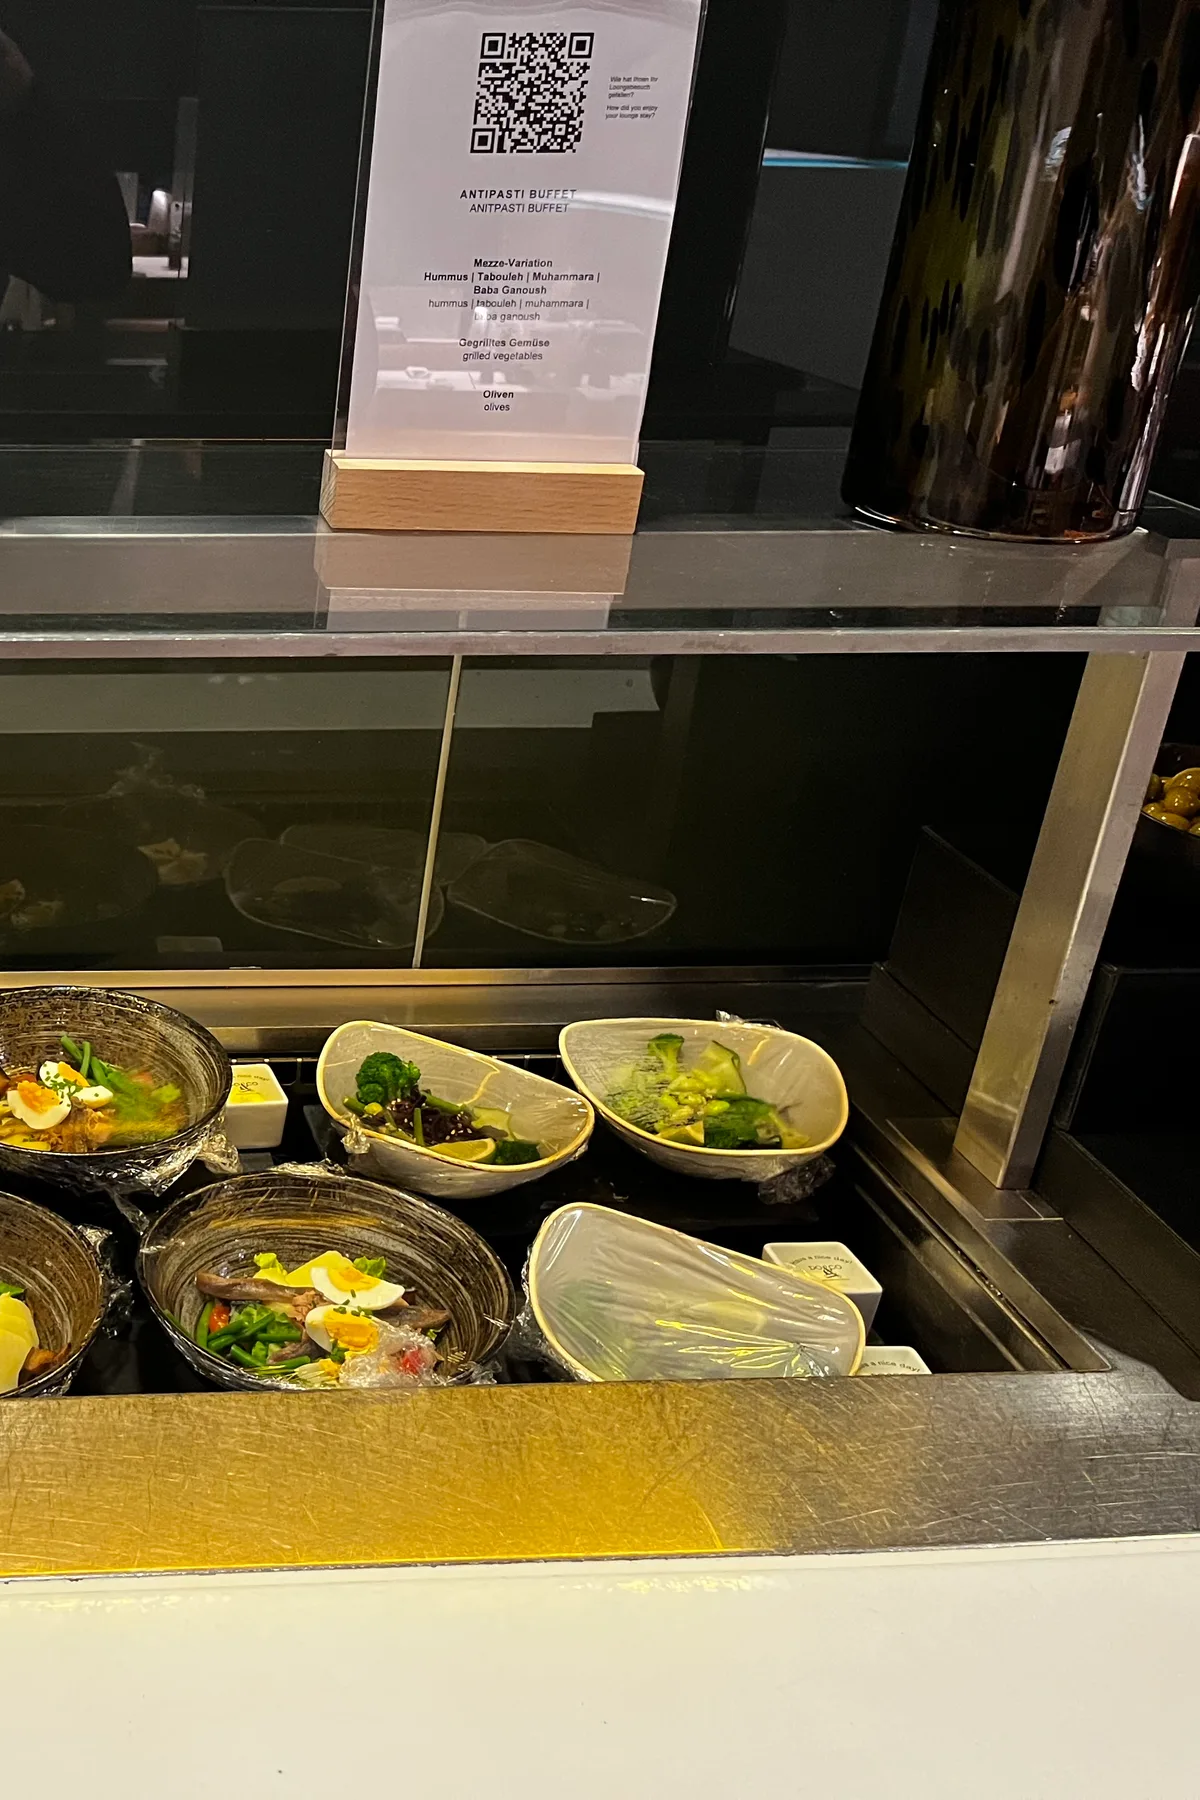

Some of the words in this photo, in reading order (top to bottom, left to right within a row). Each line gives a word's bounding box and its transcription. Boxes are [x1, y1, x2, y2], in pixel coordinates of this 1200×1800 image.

[460, 189, 525, 199] ANTIPASTI
[529, 189, 577, 199] BUFFET
[469, 203, 525, 213] ANITPASTI
[527, 203, 569, 213] BUFFET
[473, 258, 553, 268] Mezze-Variation
[423, 272, 469, 281] Hummus
[477, 272, 524, 281] Tabouleh
[532, 272, 594, 282] Muhammara
[473, 285, 499, 295] Baba
[501, 285, 547, 295] Ganoush
[428, 299, 468, 308] hummus
[476, 299, 517, 308] tabouleh
[525, 299, 584, 308] muhammara
[474, 312, 498, 321] bba
[500, 312, 541, 322] ganoush
[459, 338, 506, 349] Gegrilltes
[509, 338, 550, 347] Gemüse
[462, 351, 491, 362] grilled
[493, 351, 543, 362] vegetables
[483, 390, 514, 399] Oliven
[483, 403, 510, 412] olives
